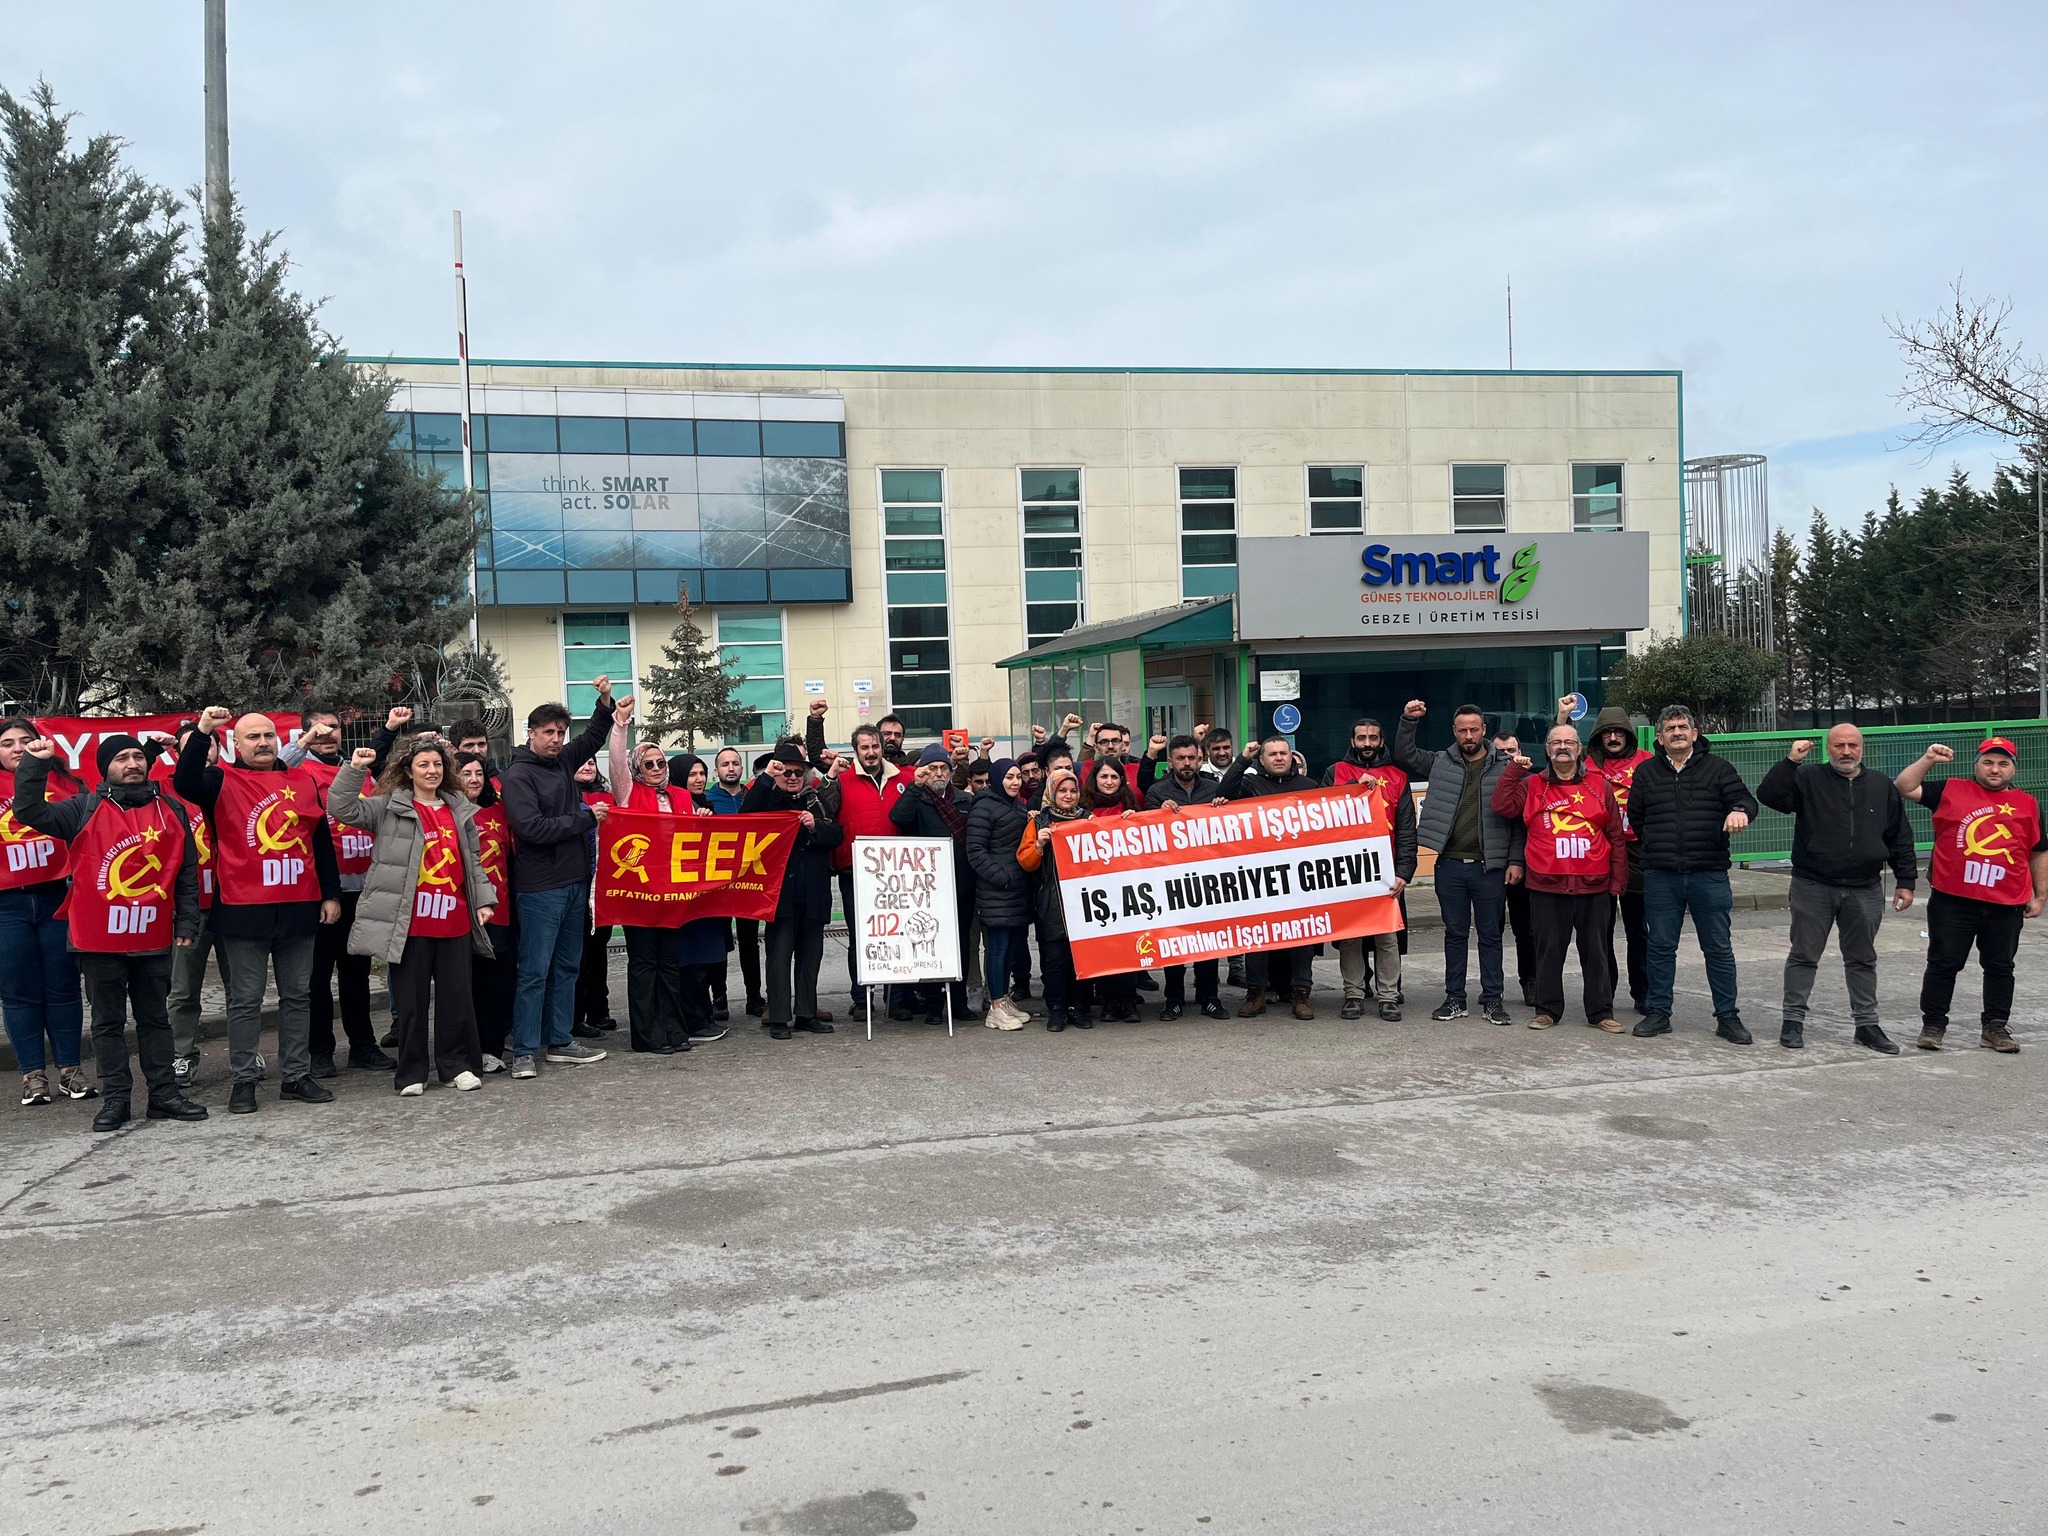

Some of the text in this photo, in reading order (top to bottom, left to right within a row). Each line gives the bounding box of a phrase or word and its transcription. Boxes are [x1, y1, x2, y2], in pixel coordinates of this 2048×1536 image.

[542, 475, 669, 492] think. SMART
[562, 494, 670, 510] act. SOLAR
[1361, 544, 1500, 586] Smart
[1361, 588, 1498, 605] GÜNEŞ TEKNOLOJİLERİ
[1361, 608, 1539, 625] GEBZE ÜRETİM TESİSİ
[1065, 793, 1373, 865] YAŞASIN SMART İŞÇİSİNİN
[6, 839, 55, 872] DİP
[341, 830, 374, 859] DİP
[1555, 833, 1591, 859] DİP
[262, 853, 305, 886] DİP
[863, 846, 941, 874] SMART
[1963, 858, 2006, 888] DİP
[876, 873, 937, 893] SOLAR
[1080, 848, 1382, 927] İŞ, AŞ, HÜRRİYET GREVİ!
[107, 900, 157, 934] DİP
[416, 888, 457, 920] DİP
[1157, 925, 1234, 959] DEVRİMCİ
[1236, 920, 1270, 949] İŞÇİ
[1272, 911, 1332, 942] PARTİSİ
[865, 941, 901, 961] GÜN
